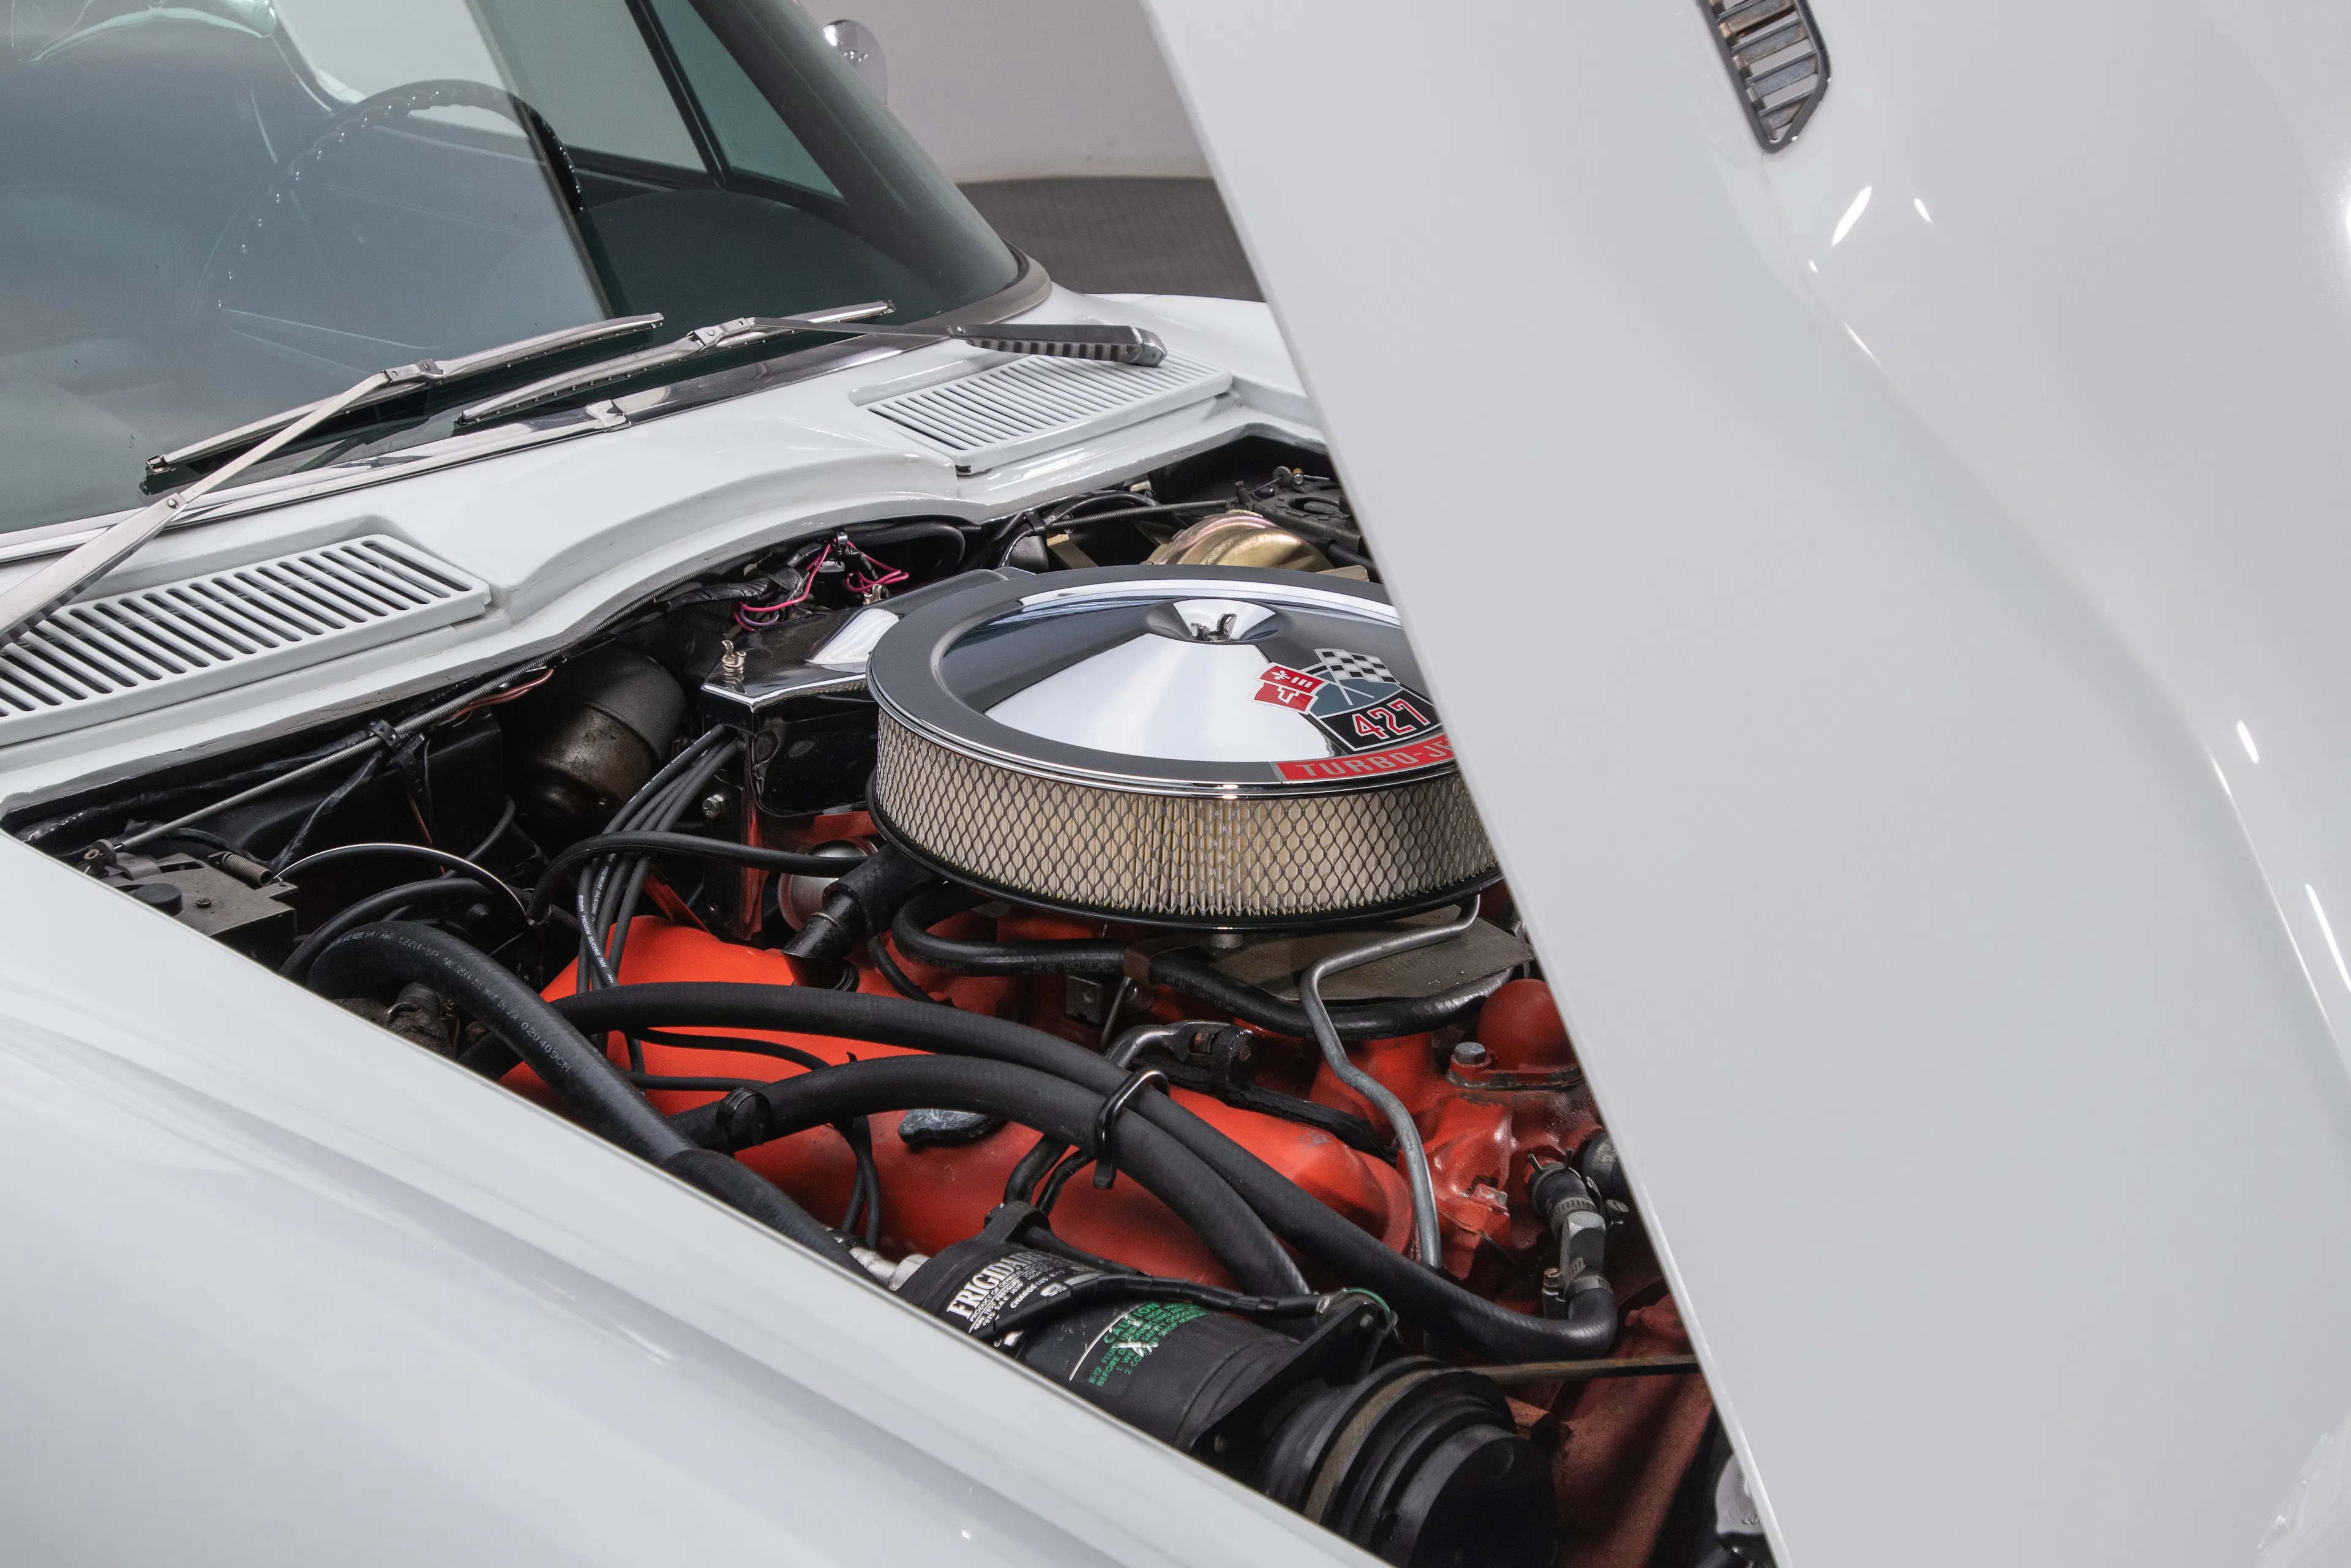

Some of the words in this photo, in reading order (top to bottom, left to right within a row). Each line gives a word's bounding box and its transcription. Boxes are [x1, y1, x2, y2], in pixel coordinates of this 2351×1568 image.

[1352, 697, 1431, 740] 427
[1295, 739, 1453, 776] TURBO-JE
[598, 866, 609, 890] PREMIUM
[591, 891, 600, 915] SILICONE
[581, 915, 591, 935] PREMIUM
[588, 936, 601, 956] SILICONE
[969, 1295, 993, 1322] PRODUCT
[991, 1286, 1000, 1296] OF
[999, 1270, 1024, 1288] GENERAL
[983, 1302, 997, 1315] TEST
[996, 1278, 1021, 1302] PRESSURE
[1010, 1283, 1038, 1308] CHARGE
[1089, 1366, 1103, 1384] R-12
[1097, 1356, 1120, 1387] BEFORE
